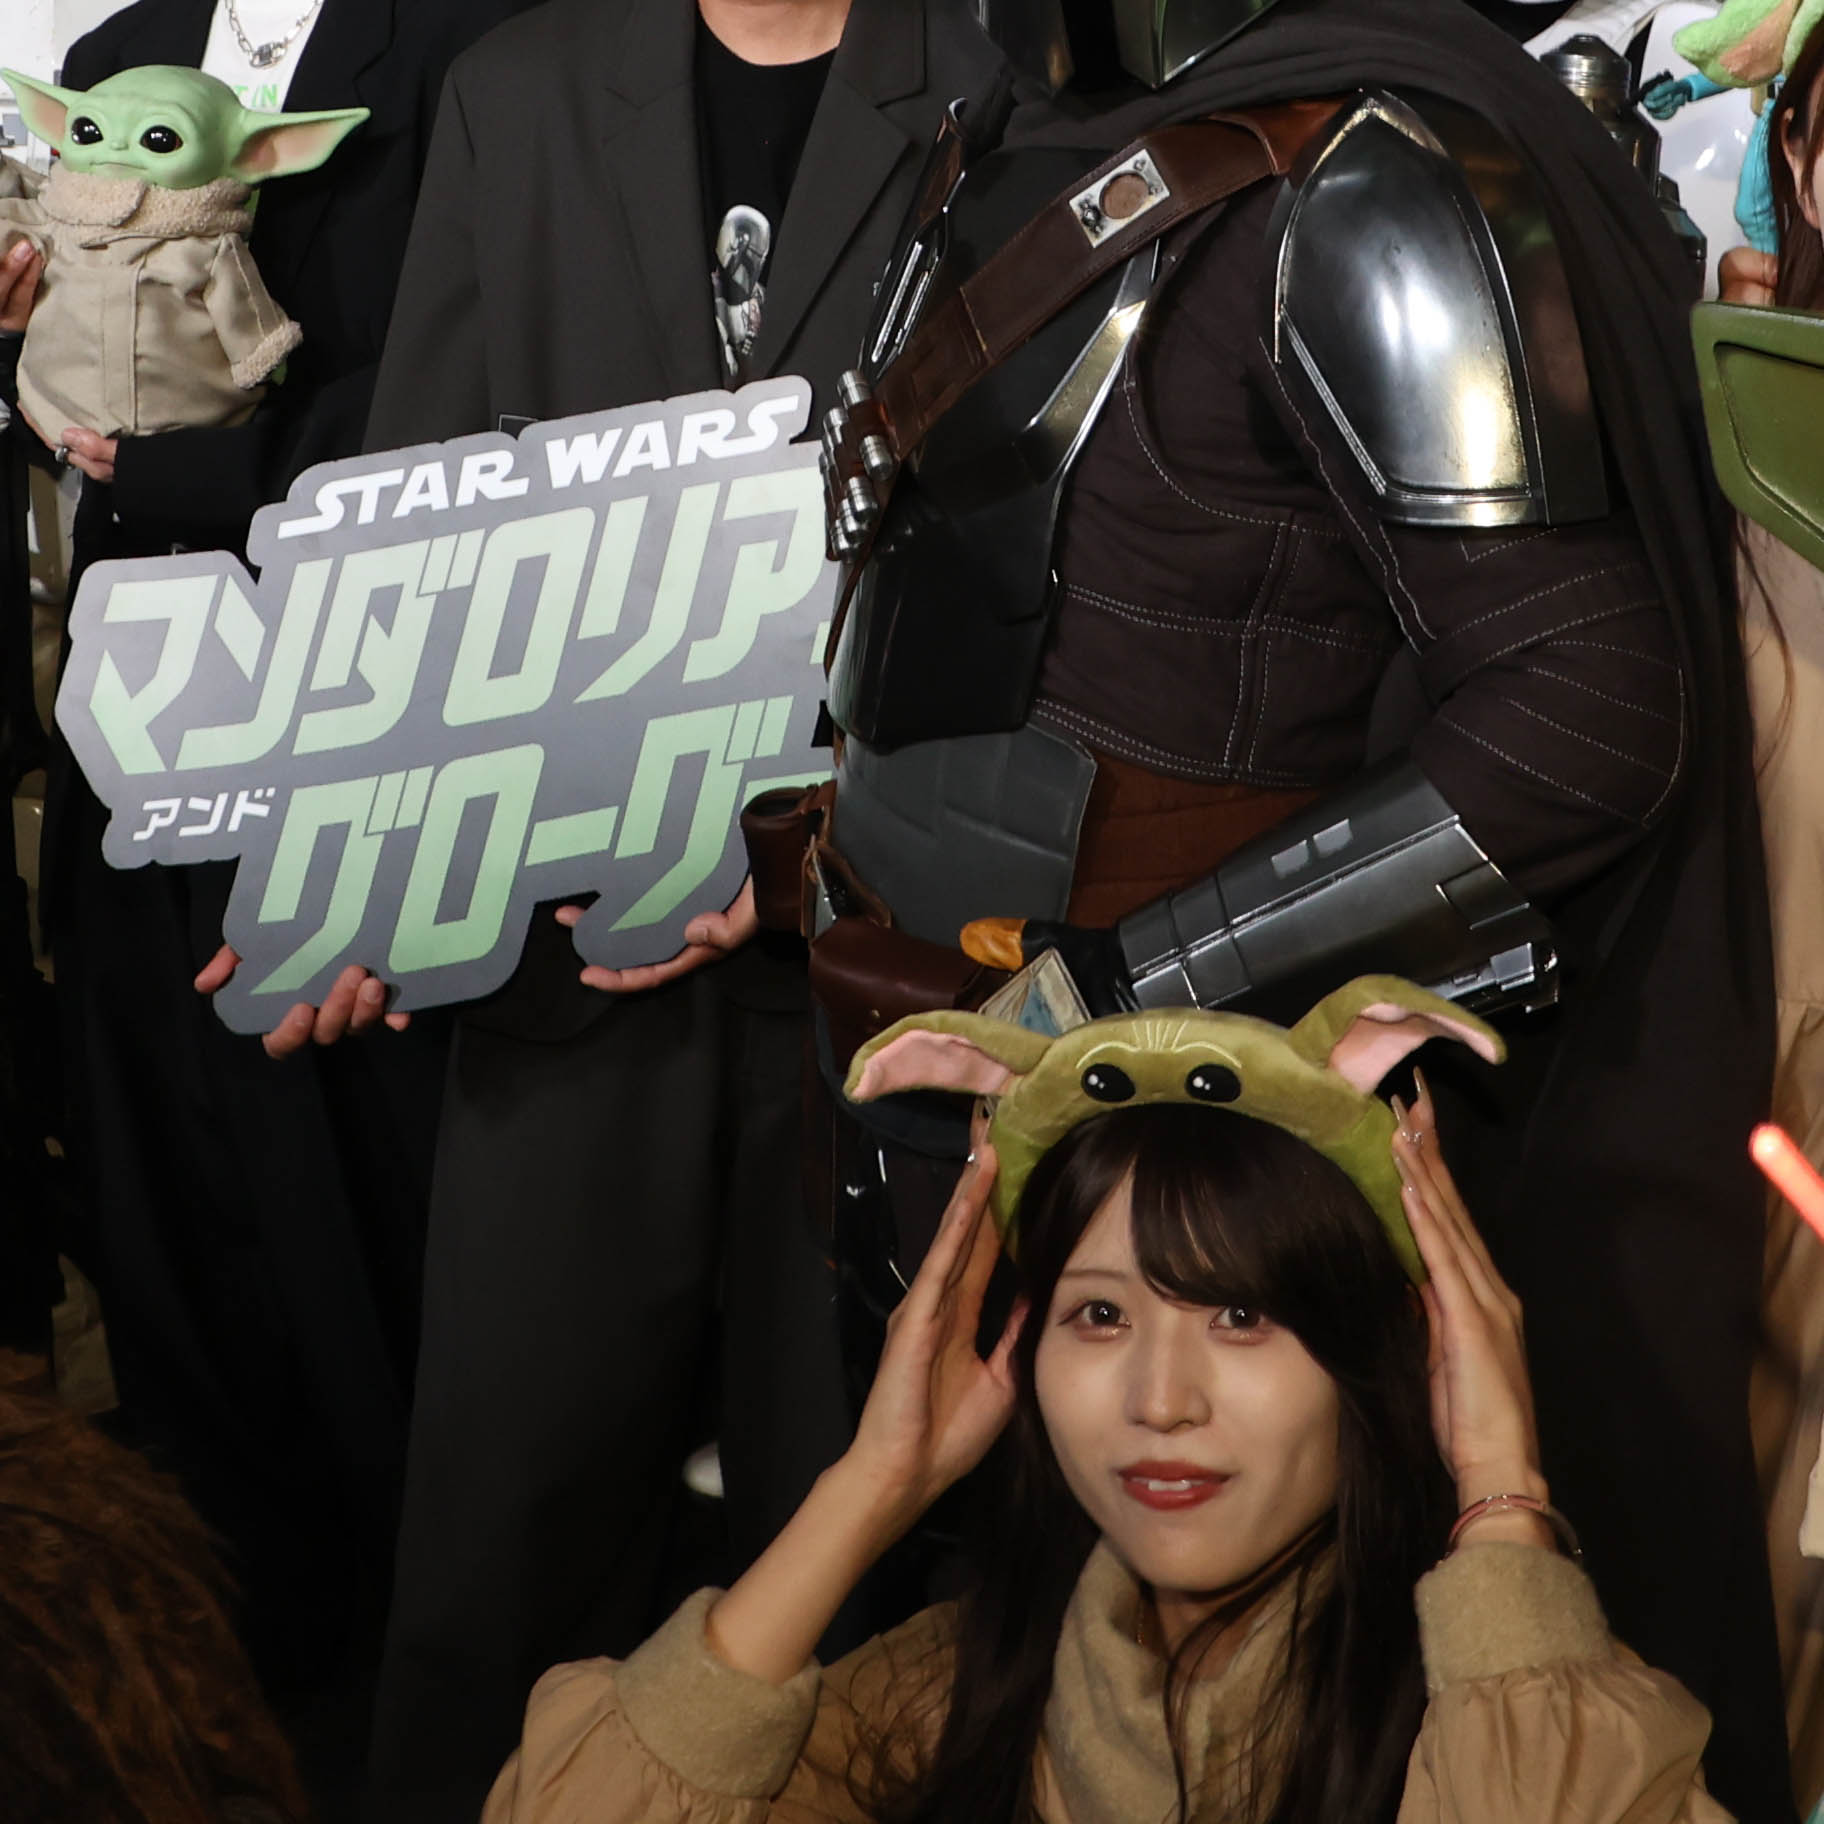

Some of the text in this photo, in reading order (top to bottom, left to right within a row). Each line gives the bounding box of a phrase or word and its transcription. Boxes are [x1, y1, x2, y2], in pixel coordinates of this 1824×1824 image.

[277, 393, 802, 540] STAR WARS
[88, 466, 832, 775] マンダロリア
[132, 786, 276, 842] アンド
